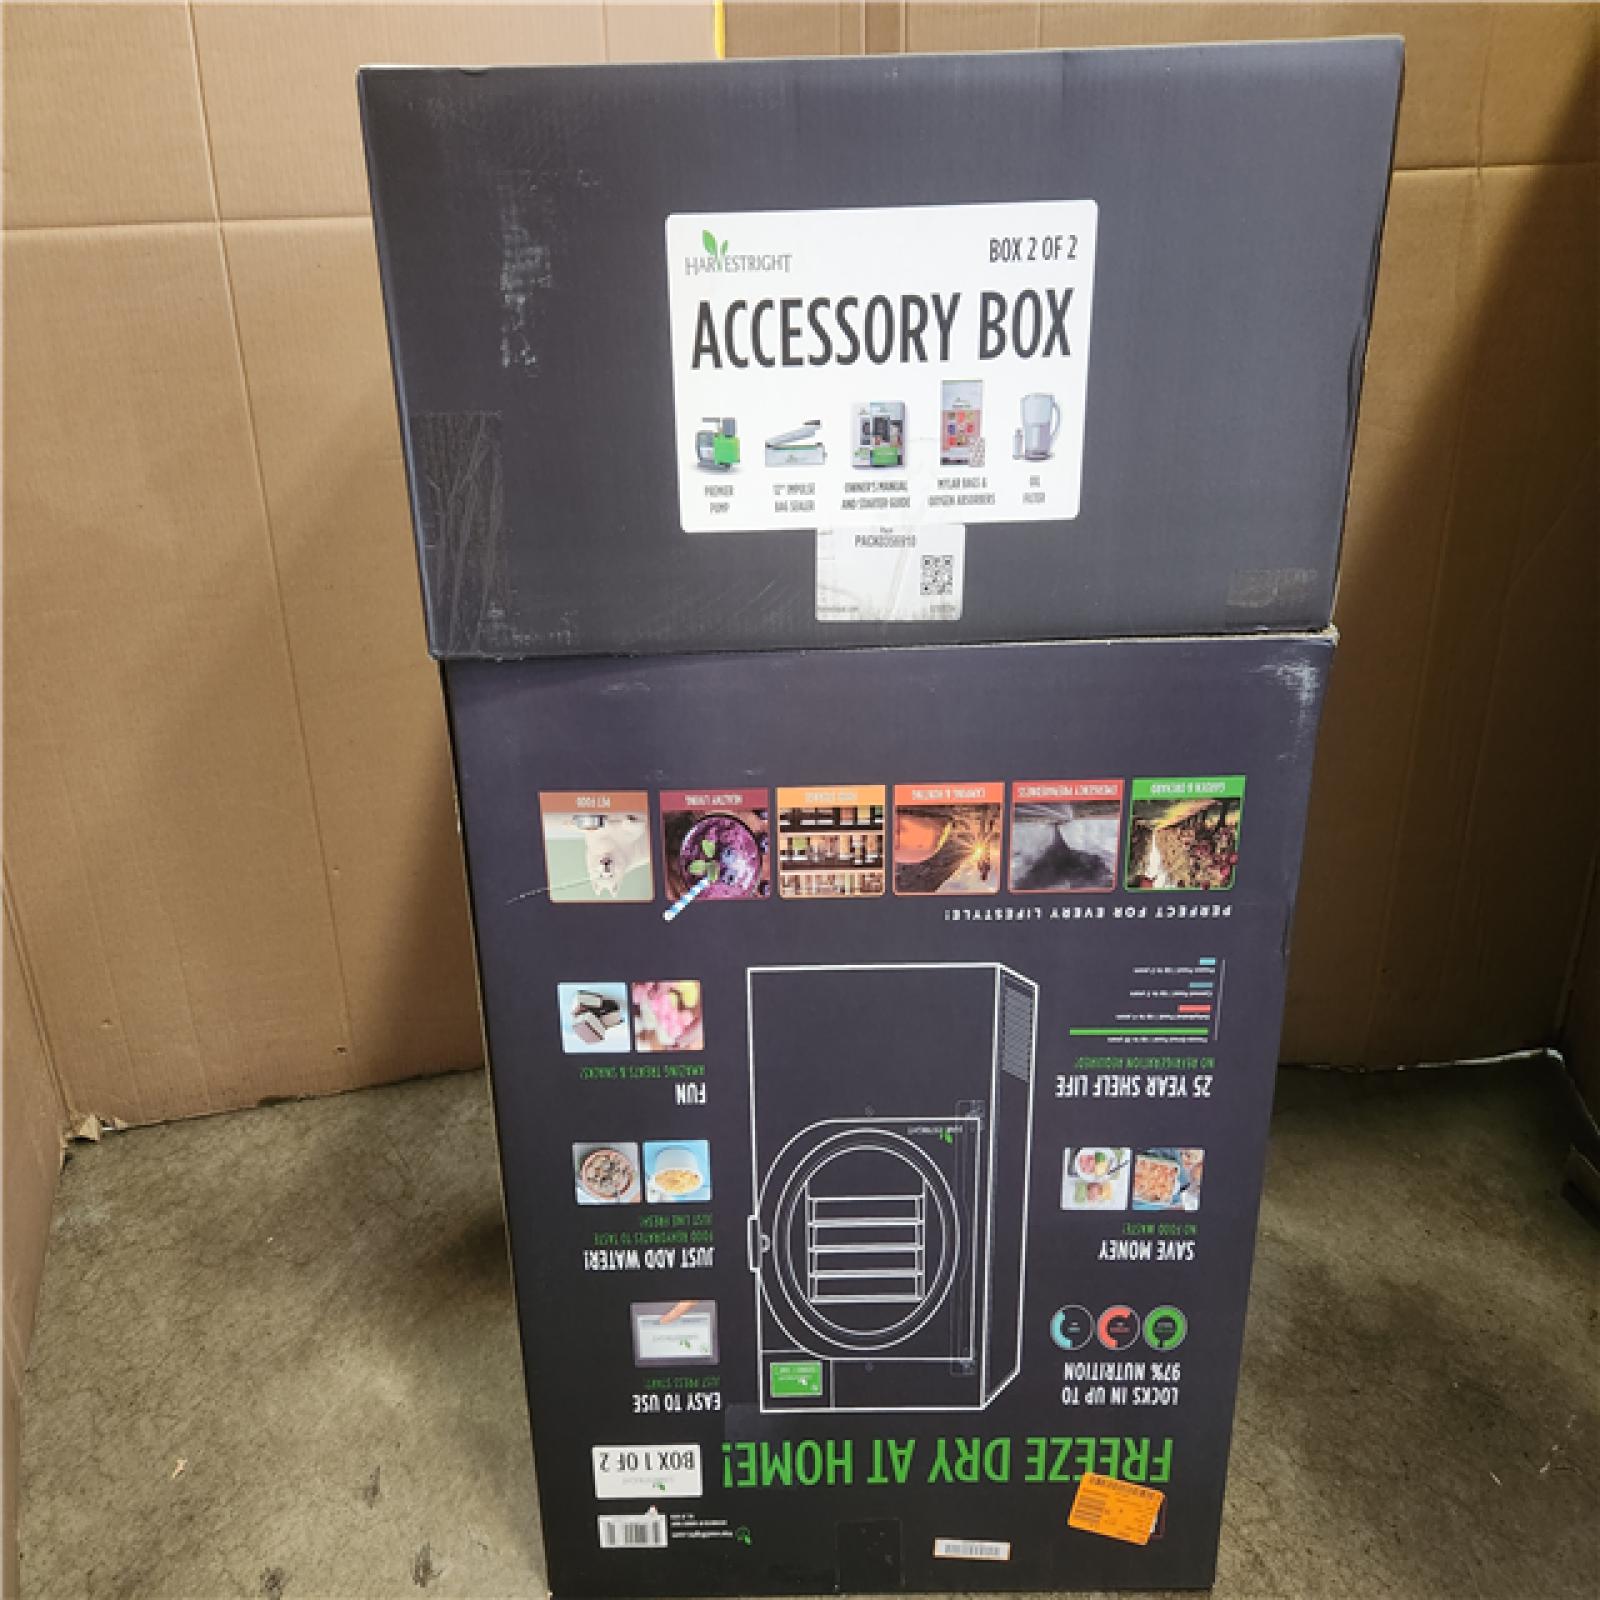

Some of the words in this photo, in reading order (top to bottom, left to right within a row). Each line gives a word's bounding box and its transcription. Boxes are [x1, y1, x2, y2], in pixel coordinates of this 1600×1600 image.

[989, 237, 1023, 263] BOX
[1026, 236, 1038, 261] 2
[1042, 234, 1063, 261] OF
[1066, 234, 1078, 261] 2
[691, 292, 961, 370] ACCESSORY
[979, 286, 1074, 361] BOX
[944, 906, 1042, 921] LIFESTYLE!
[1049, 906, 1106, 920] EVERY
[1112, 905, 1147, 919] FOR
[1154, 904, 1232, 919] PERFECT
[674, 1082, 706, 1105] FUN
[1054, 1074, 1089, 1098] LIFE
[1092, 1074, 1141, 1098] SHELF
[1145, 1074, 1188, 1098] YEAR
[1192, 1074, 1214, 1098] 25
[582, 1249, 641, 1271] WATER!
[644, 1248, 675, 1270] ADD
[679, 1247, 715, 1269] JUST
[1096, 1239, 1153, 1261] MONEY
[1155, 1239, 1196, 1261] SAVE
[1063, 1362, 1146, 1381] NUTRITION
[1151, 1362, 1181, 1381] 97%
[631, 1394, 660, 1413] USE
[664, 1394, 683, 1412] TO
[686, 1391, 721, 1411] EASY
[1062, 1386, 1081, 1405] TO
[1084, 1386, 1106, 1405] UP
[1110, 1386, 1128, 1405] IN
[1132, 1386, 1179, 1405] LOCKS
[599, 1452, 609, 1473] 2
[616, 1452, 638, 1472] OF
[643, 1452, 652, 1472] 1
[657, 1451, 695, 1472] BOX
[720, 1439, 853, 1488] HOME!
[866, 1438, 916, 1484] AT
[927, 1436, 1011, 1485] DRY
[1024, 1436, 1174, 1484] FREEZE
